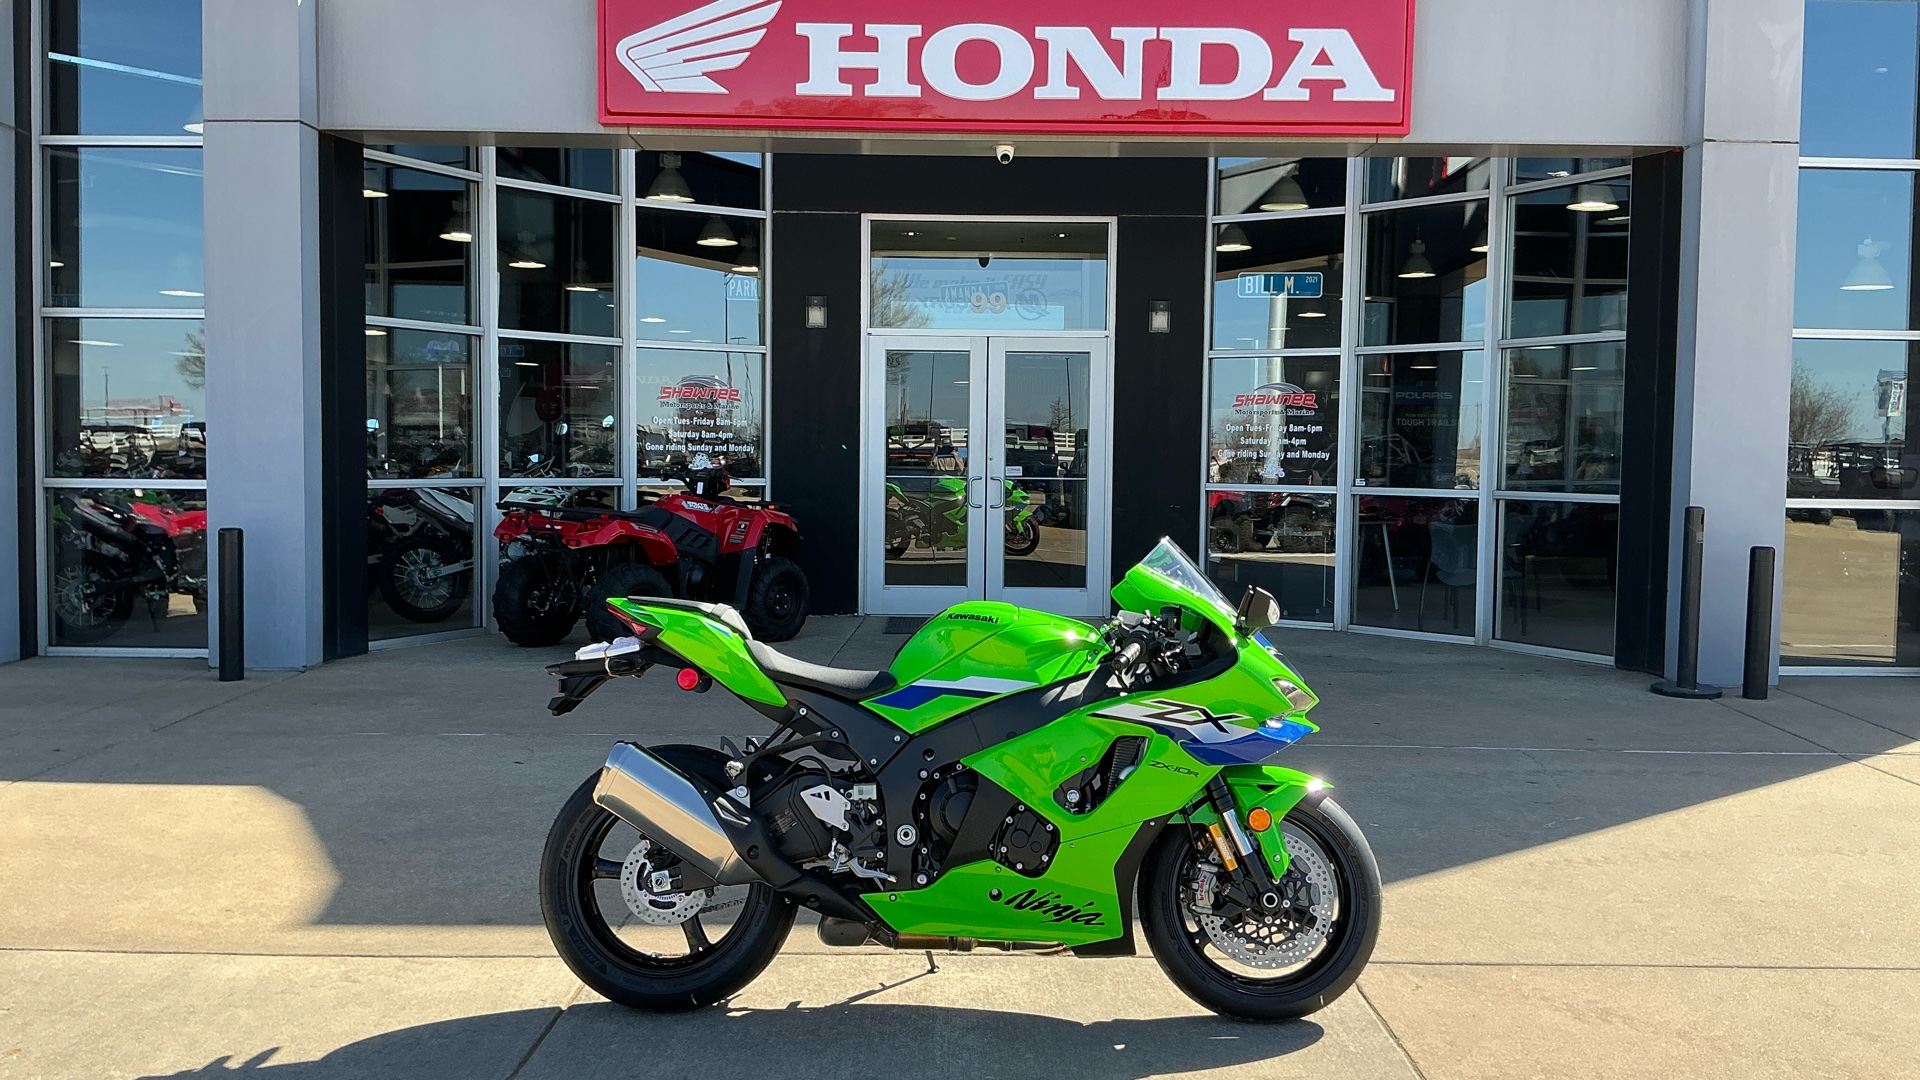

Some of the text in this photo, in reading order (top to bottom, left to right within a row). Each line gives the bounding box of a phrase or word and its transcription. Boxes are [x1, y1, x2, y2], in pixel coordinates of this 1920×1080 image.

[795, 22, 1395, 101] HONDA
[1245, 276, 1300, 294] BILL M.
[970, 292, 1007, 314] 99
[1395, 391, 1453, 399] POLARIS
[660, 401, 706, 410] Motorsports
[1235, 409, 1277, 417] Motorsports
[1287, 408, 1315, 416] Marine
[653, 416, 747, 427] Open Tues-Friday 8am-6pm
[1396, 418, 1457, 427] TOUGH TRAILS
[1226, 424, 1244, 433] Open
[1289, 424, 1323, 434] 8am-6pm
[668, 430, 733, 440] Saturday 8am-4pm
[1240, 437, 1272, 446] Saturday
[645, 442, 755, 453] Gone riding Sunday and Monday
[1237, 450, 1257, 459] riding
[1286, 450, 1300, 459] and
[1301, 450, 1330, 460] Monday
[946, 612, 999, 624] Kawasaki
[1140, 698, 1247, 735] ZX
[1149, 760, 1199, 778] ZX-10R
[1215, 836, 1232, 860] SHOWA
[1199, 875, 1208, 901] brembo
[1003, 888, 1105, 926] Ninja
